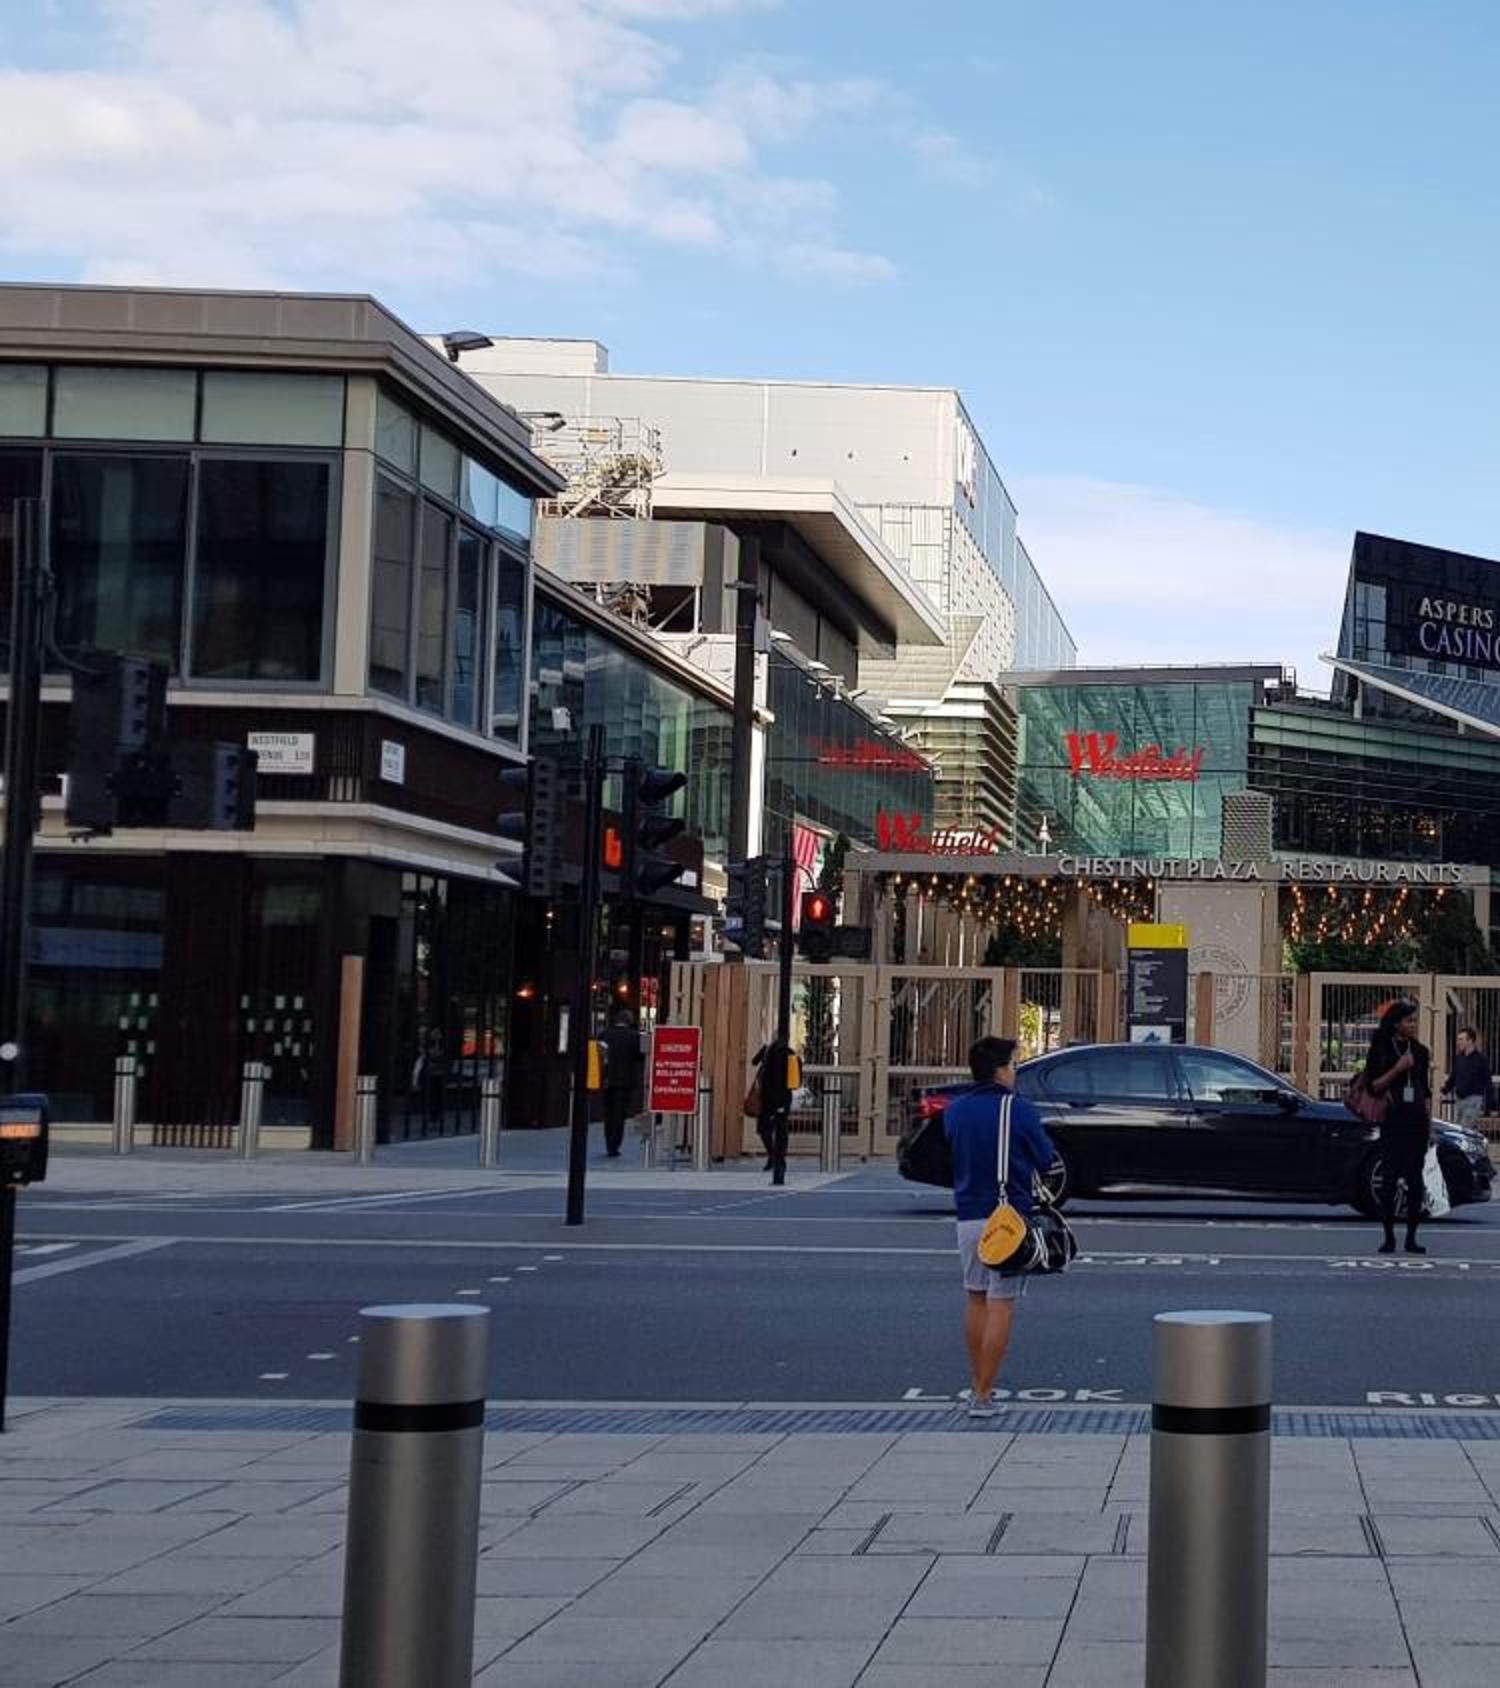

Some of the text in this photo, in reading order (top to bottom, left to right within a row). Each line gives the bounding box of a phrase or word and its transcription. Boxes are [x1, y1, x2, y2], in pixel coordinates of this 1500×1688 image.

[1419, 597, 1494, 629] ASPERS
[1064, 730, 1204, 782] Westfield
[1058, 857, 1462, 883] CHESTNUT PLAZA RESTAURANTS
[902, 1387, 1124, 1401] LOOK
